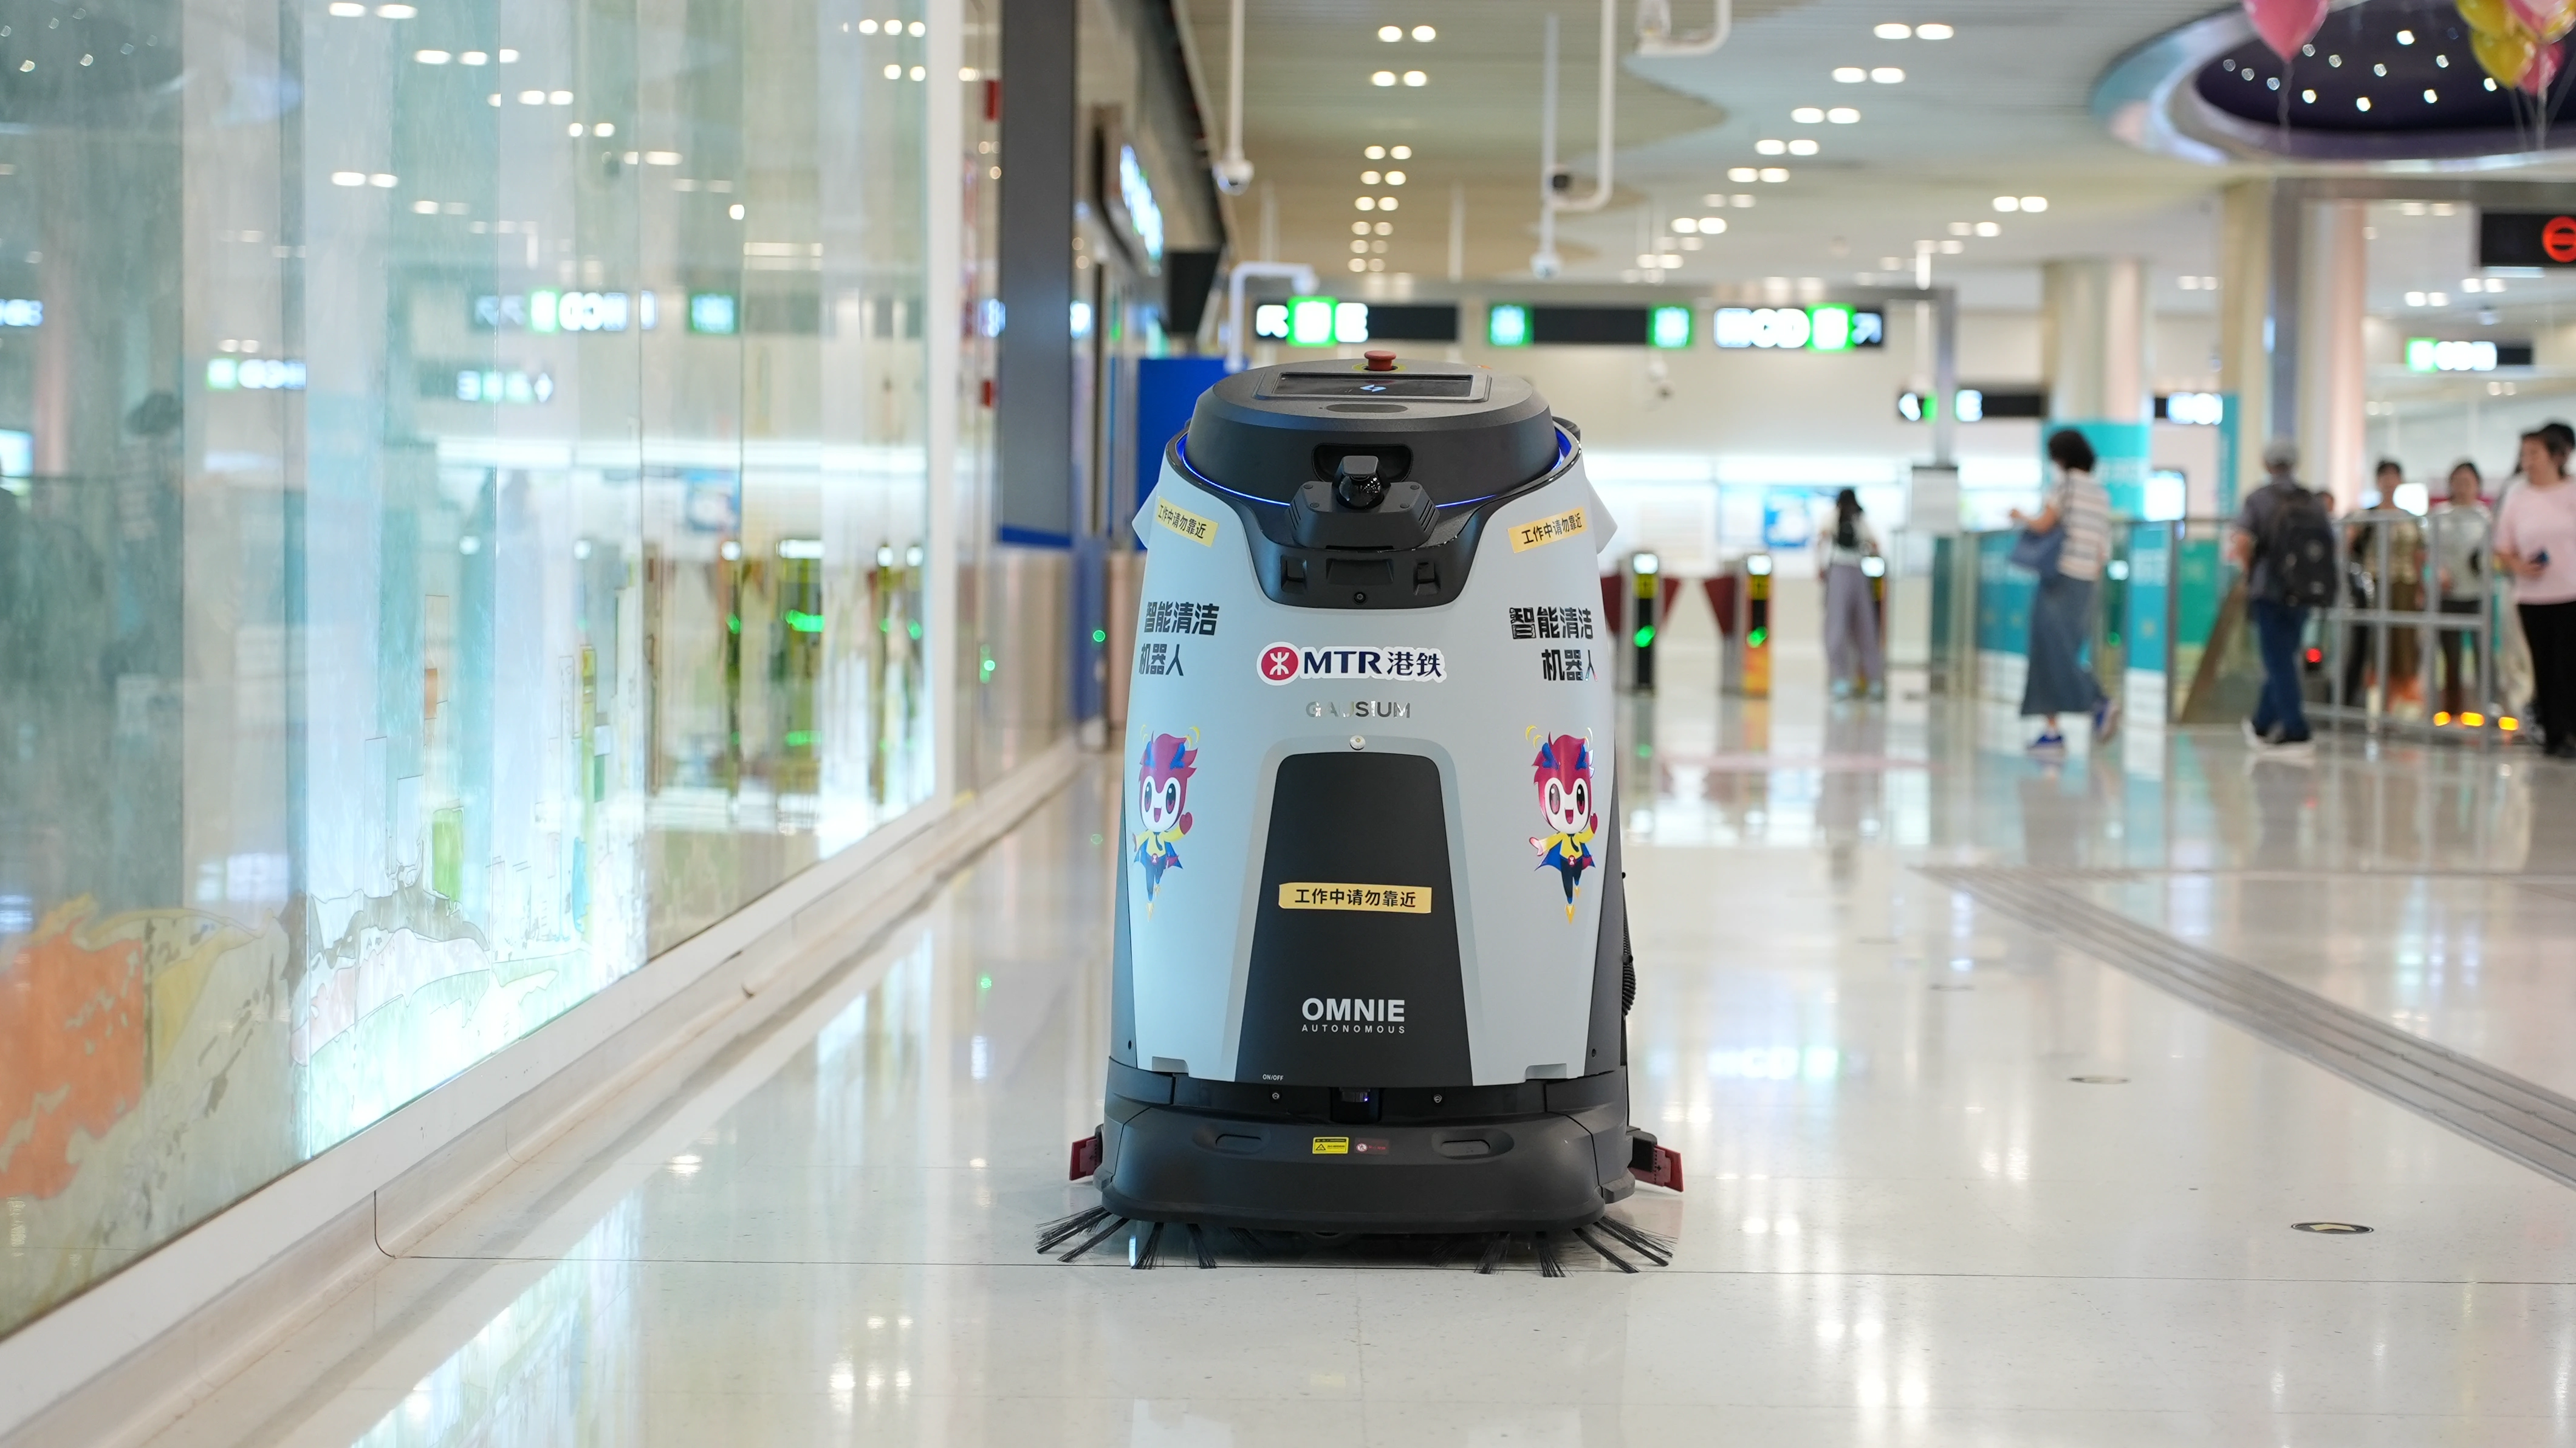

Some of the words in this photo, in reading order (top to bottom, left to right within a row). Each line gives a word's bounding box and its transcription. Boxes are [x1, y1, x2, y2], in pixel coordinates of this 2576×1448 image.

[1158, 505, 1207, 539] 工作中请勿靠近
[1521, 513, 1582, 544] 工作中请勿靠近
[1144, 601, 1219, 636] 智能清洁
[1509, 606, 1594, 640] 智能清洁
[1139, 643, 1184, 676] 机器人
[1304, 651, 1382, 674] MTR
[1387, 651, 1442, 677] 港铁
[1541, 649, 1598, 681] 机器人
[1306, 701, 1411, 718] GAUSIUM
[1295, 889, 1416, 907] 工作中请勿靠近
[1302, 998, 1405, 1022] OMNIE
[1301, 1024, 1405, 1034] AUTONOMOUS
